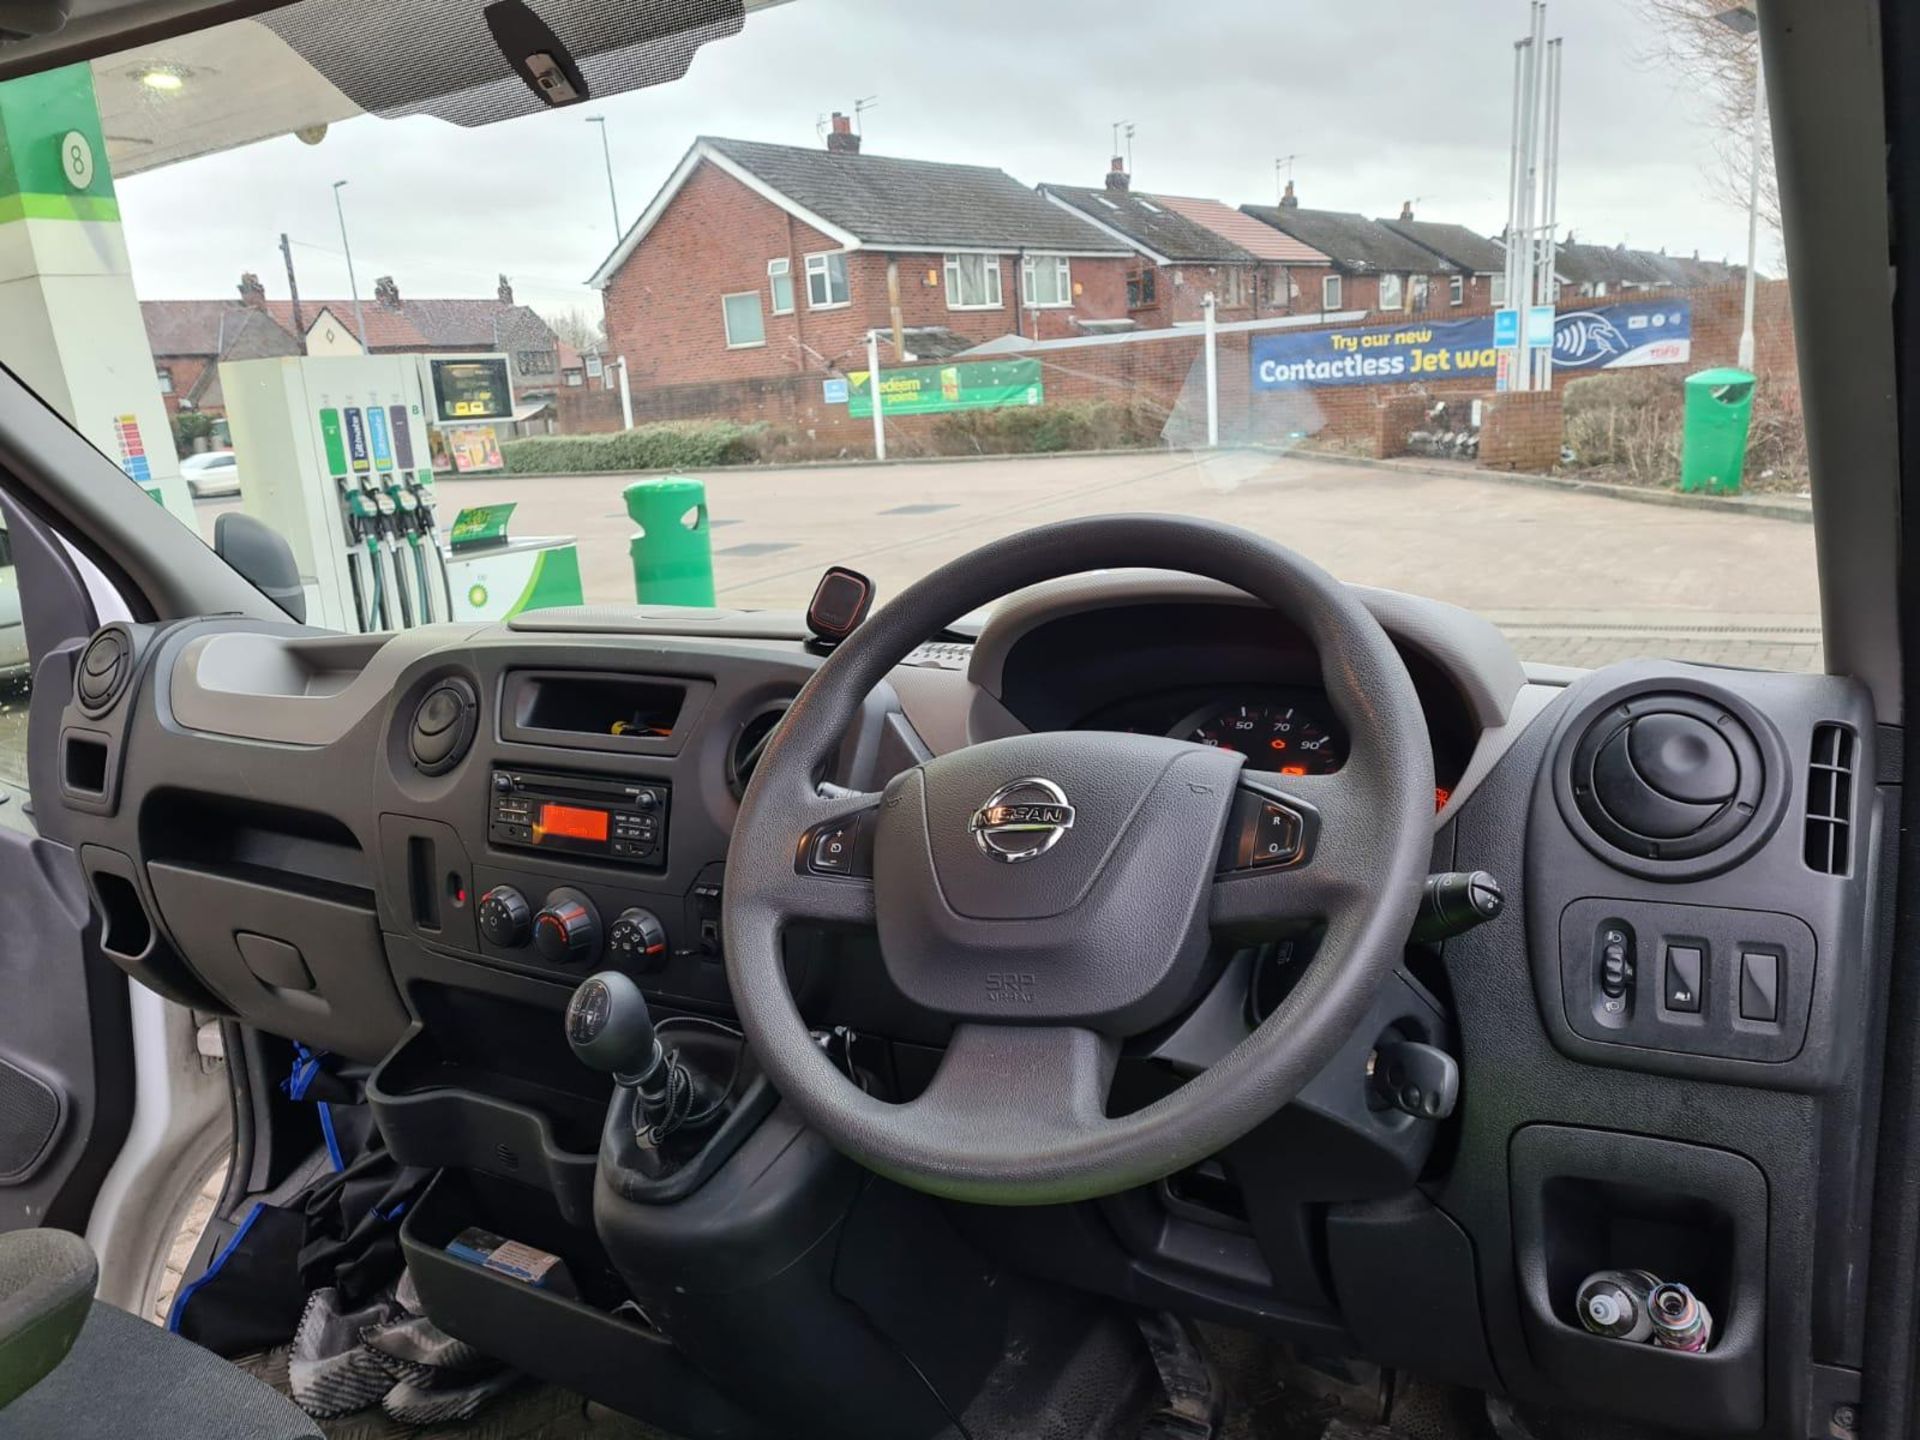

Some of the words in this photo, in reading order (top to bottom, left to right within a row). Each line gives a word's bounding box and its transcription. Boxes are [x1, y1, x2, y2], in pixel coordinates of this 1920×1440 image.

[71, 145, 84, 175] 8
[1331, 334, 1358, 351] Try
[1362, 334, 1391, 348] our
[1394, 328, 1432, 344] new
[1260, 354, 1404, 383] Contactless
[1410, 349, 1450, 373] Jet
[1455, 349, 1496, 369] wa
[879, 378, 920, 393] edeem
[1235, 721, 1253, 730] 50
[1273, 723, 1291, 732] 70
[1301, 741, 1319, 750] 90
[982, 806, 1062, 825] NISSAN
[1273, 816, 1281, 825] R
